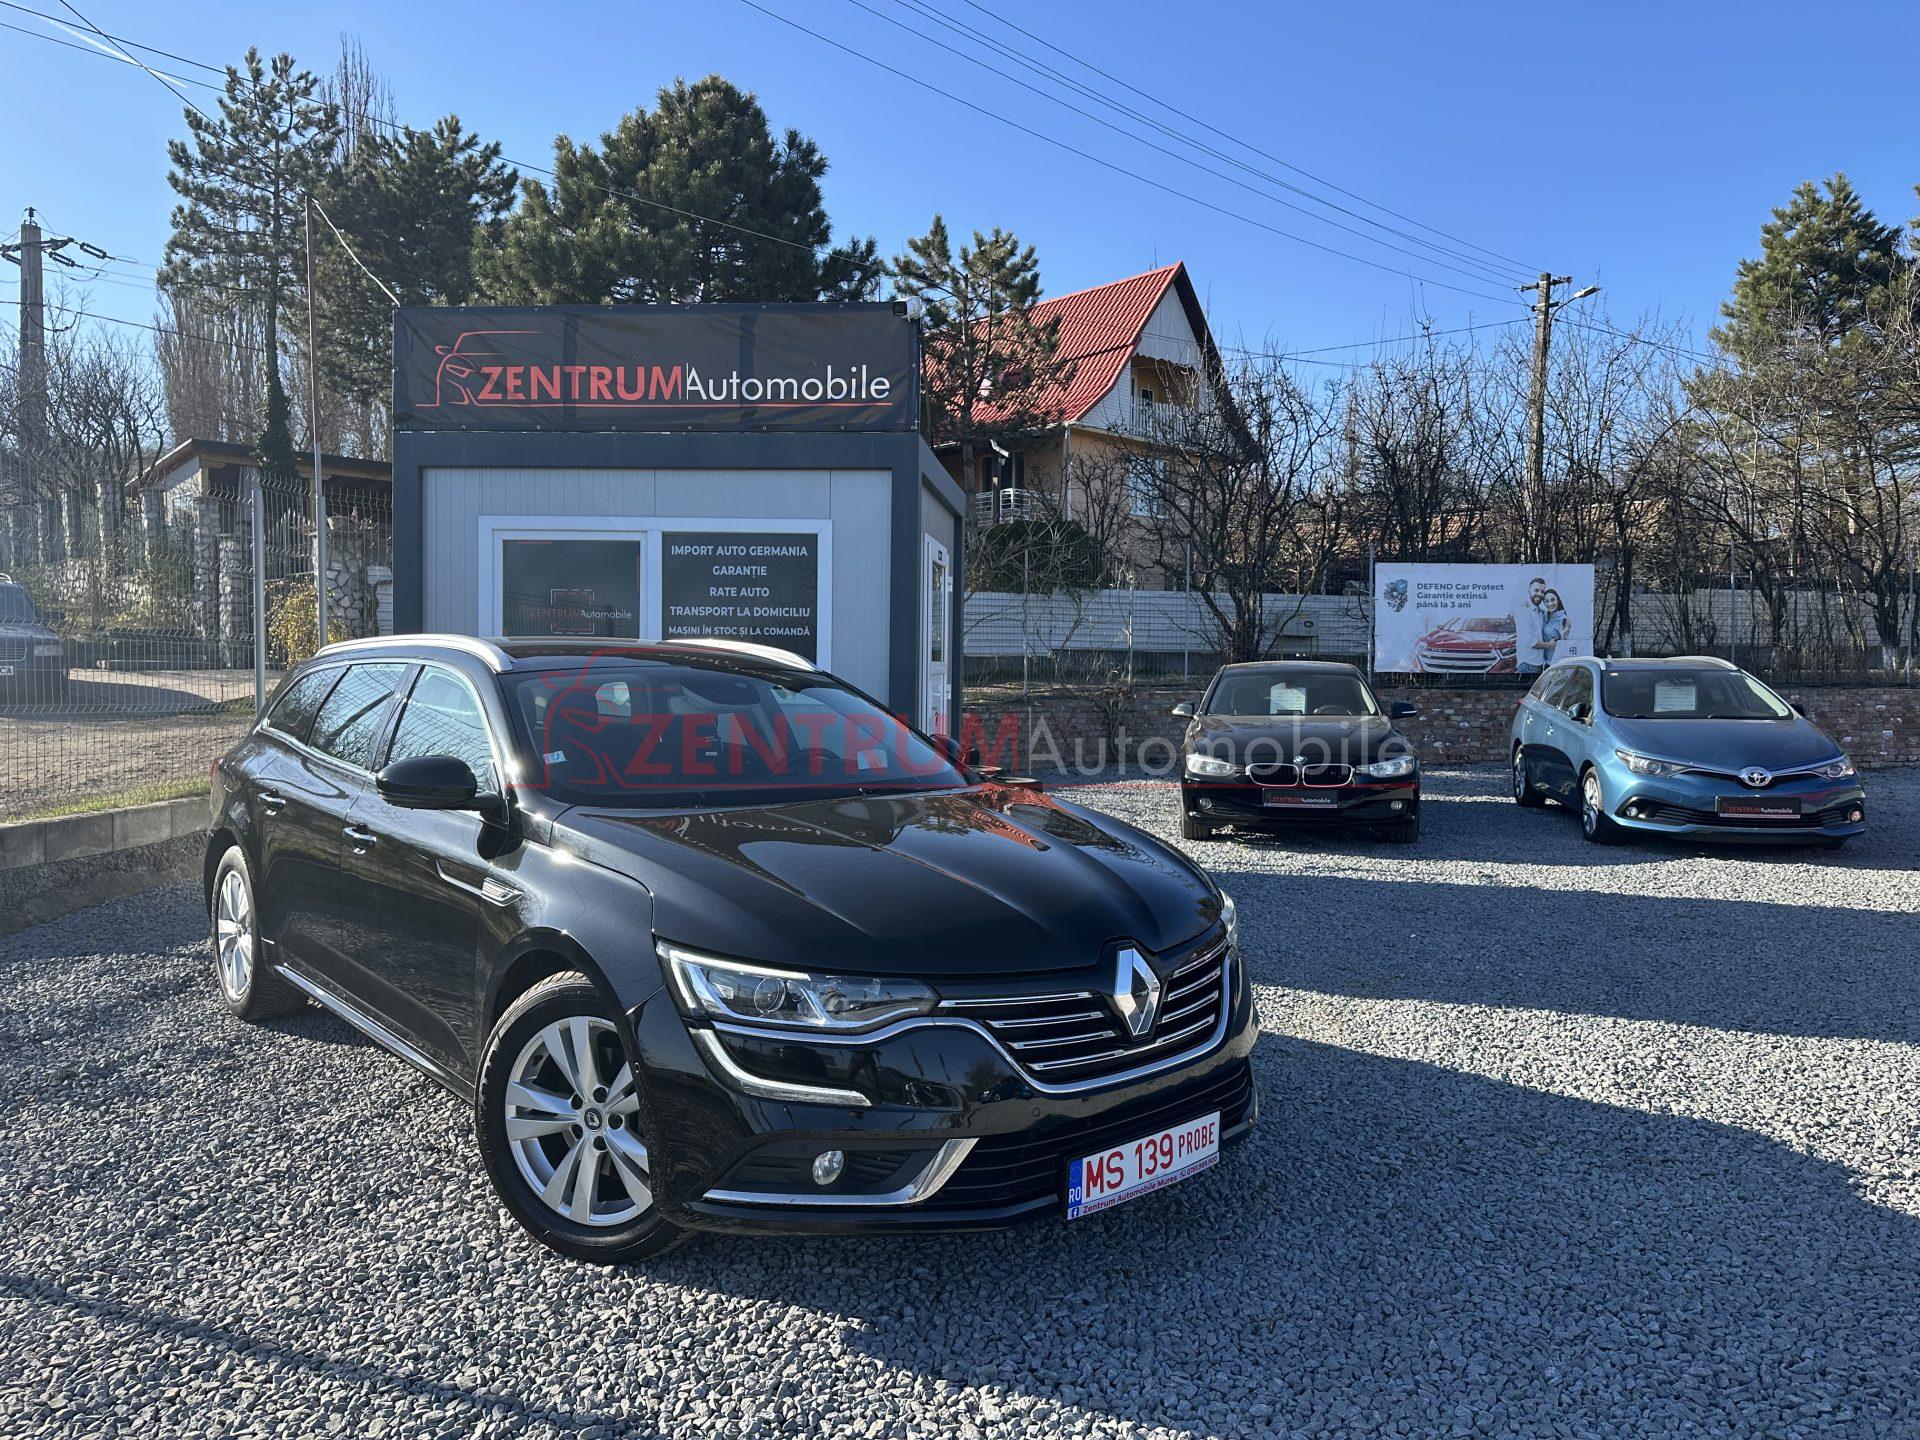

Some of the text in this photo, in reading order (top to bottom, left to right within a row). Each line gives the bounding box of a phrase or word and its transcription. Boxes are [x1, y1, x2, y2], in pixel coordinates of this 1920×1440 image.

[477, 364, 891, 400] ZENTRUM Automobile
[671, 545, 808, 557] IMPORT AUTO GERMANIA
[709, 586, 770, 597] RATE AUTO
[1416, 583, 1504, 591] DEFEND Car Protect
[581, 609, 632, 619] Automobile
[669, 606, 810, 618] TRANSPORT LA DOMICILIU
[714, 626, 738, 635] STOC
[750, 627, 761, 636] LA
[1085, 1122, 1216, 1198] MS 139 PROBE
[1068, 1186, 1082, 1204] RO
[1083, 1196, 1116, 1214] Zentrum
[1117, 1181, 1157, 1203] Automobile
